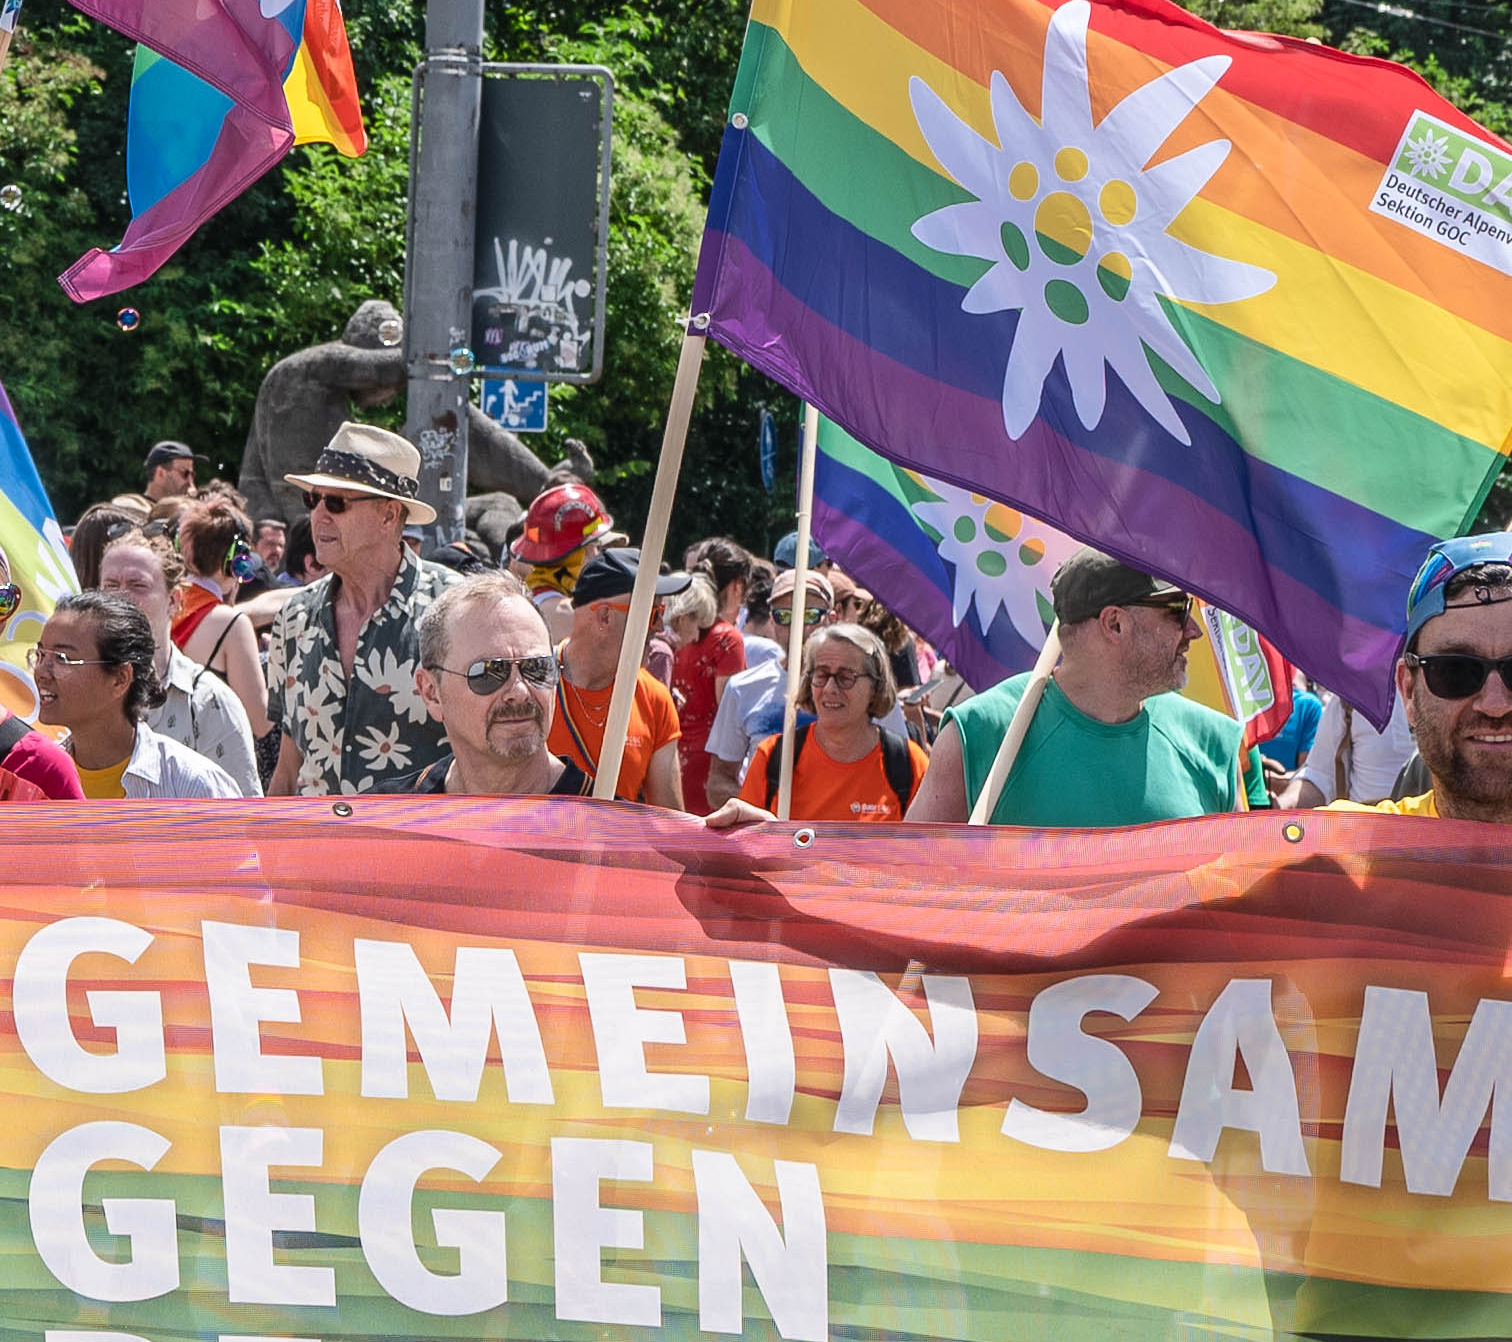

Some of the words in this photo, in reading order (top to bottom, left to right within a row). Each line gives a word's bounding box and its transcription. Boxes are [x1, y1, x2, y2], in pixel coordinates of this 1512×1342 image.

[1377, 192, 1434, 230] Sektion
[1436, 221, 1471, 247] GOC
[1386, 173, 1463, 221] Deutscher
[1228, 623, 1271, 702] DAV
